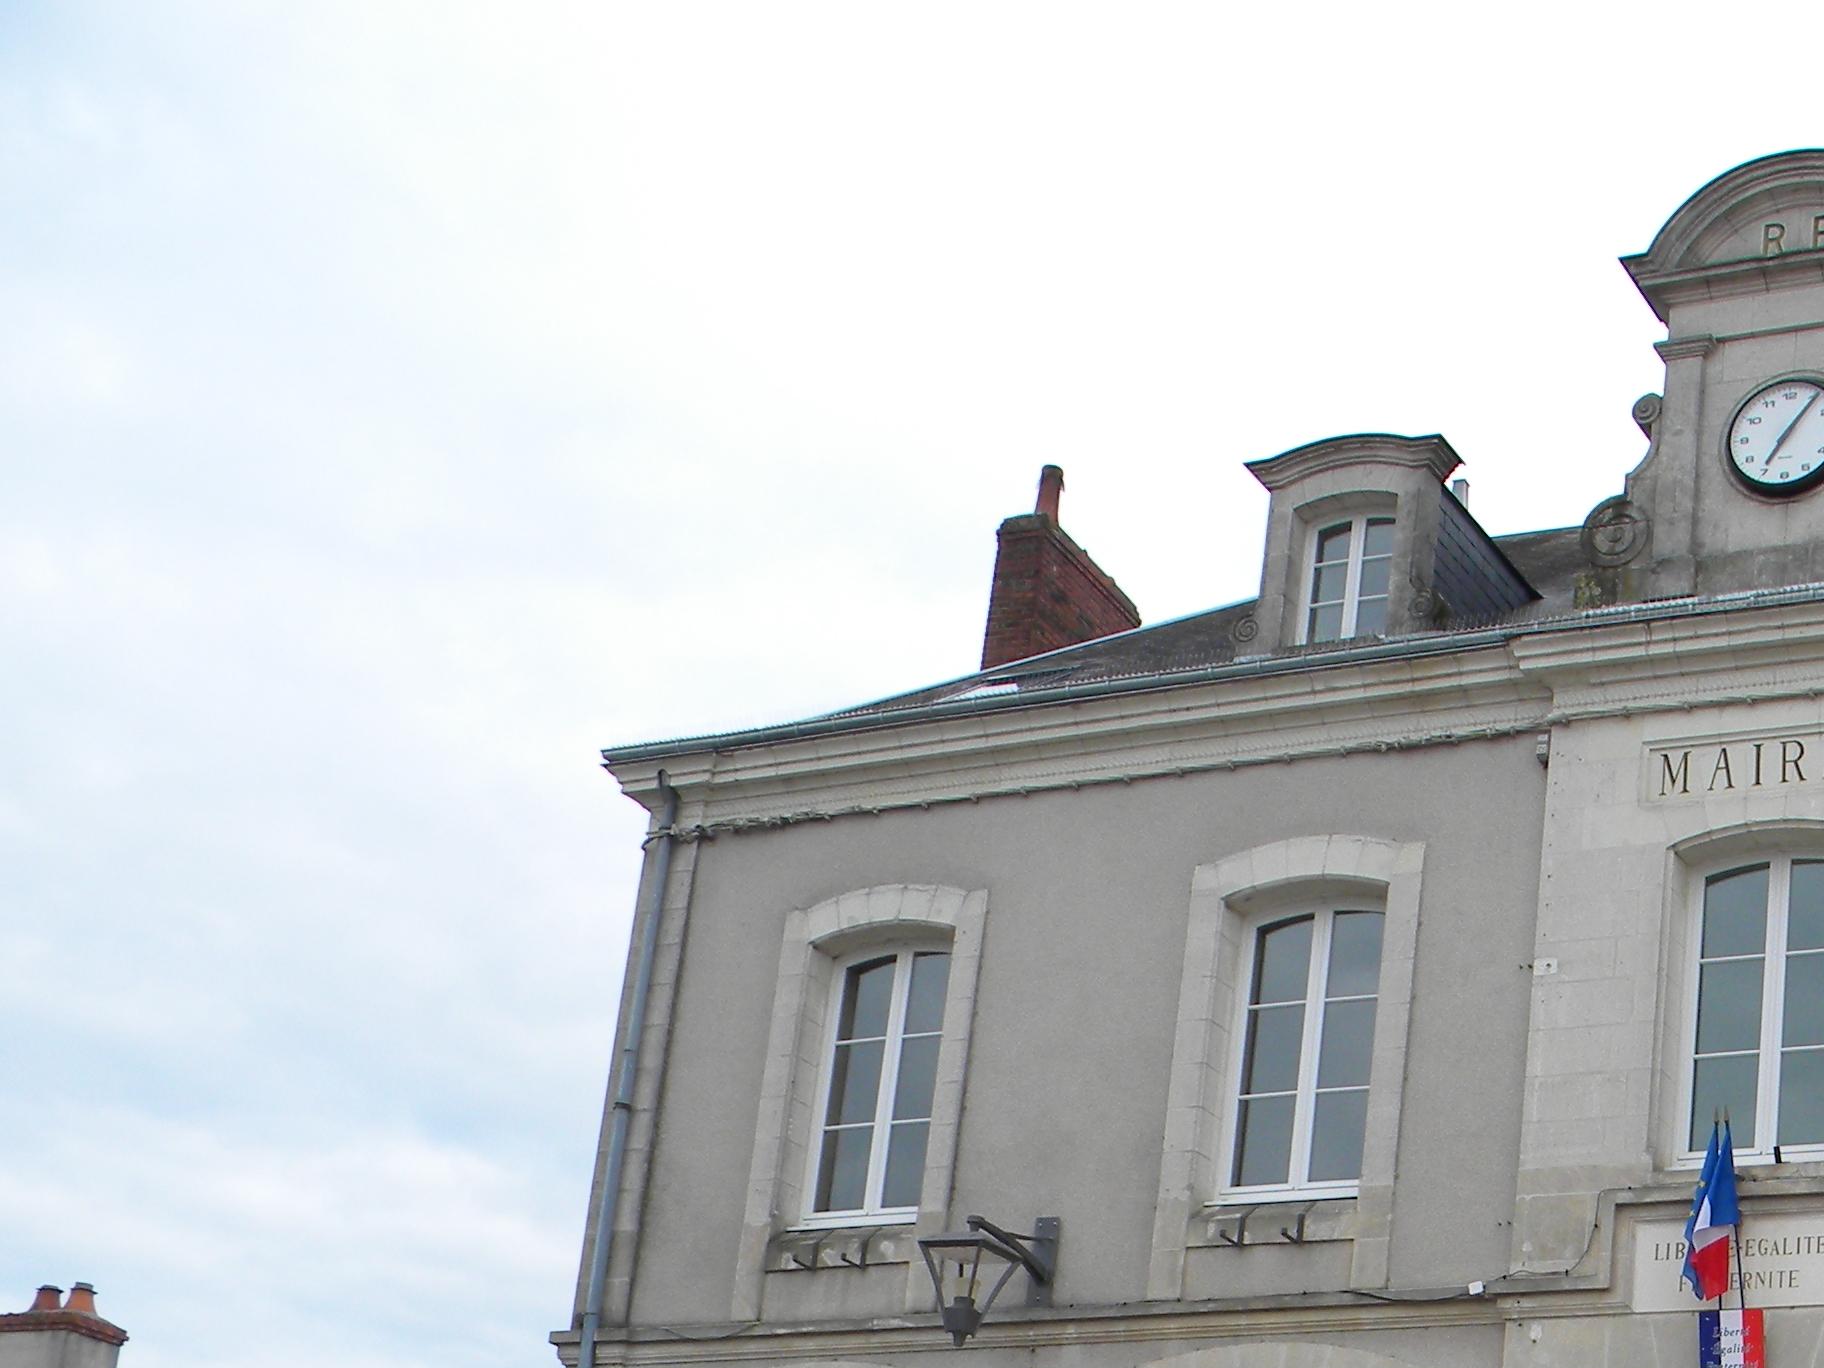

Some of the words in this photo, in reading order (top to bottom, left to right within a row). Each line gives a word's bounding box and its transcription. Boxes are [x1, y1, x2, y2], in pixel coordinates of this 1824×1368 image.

[1783, 391, 1797, 400] 12
[1762, 400, 1775, 408] 11
[1747, 416, 1761, 425] 10
[1740, 437, 1749, 445] 9
[1745, 455, 1754, 463] 8
[1760, 468, 1768, 476] 7
[1780, 471, 1789, 479] 6
[1679, 1270, 1799, 1291] FERNITE
